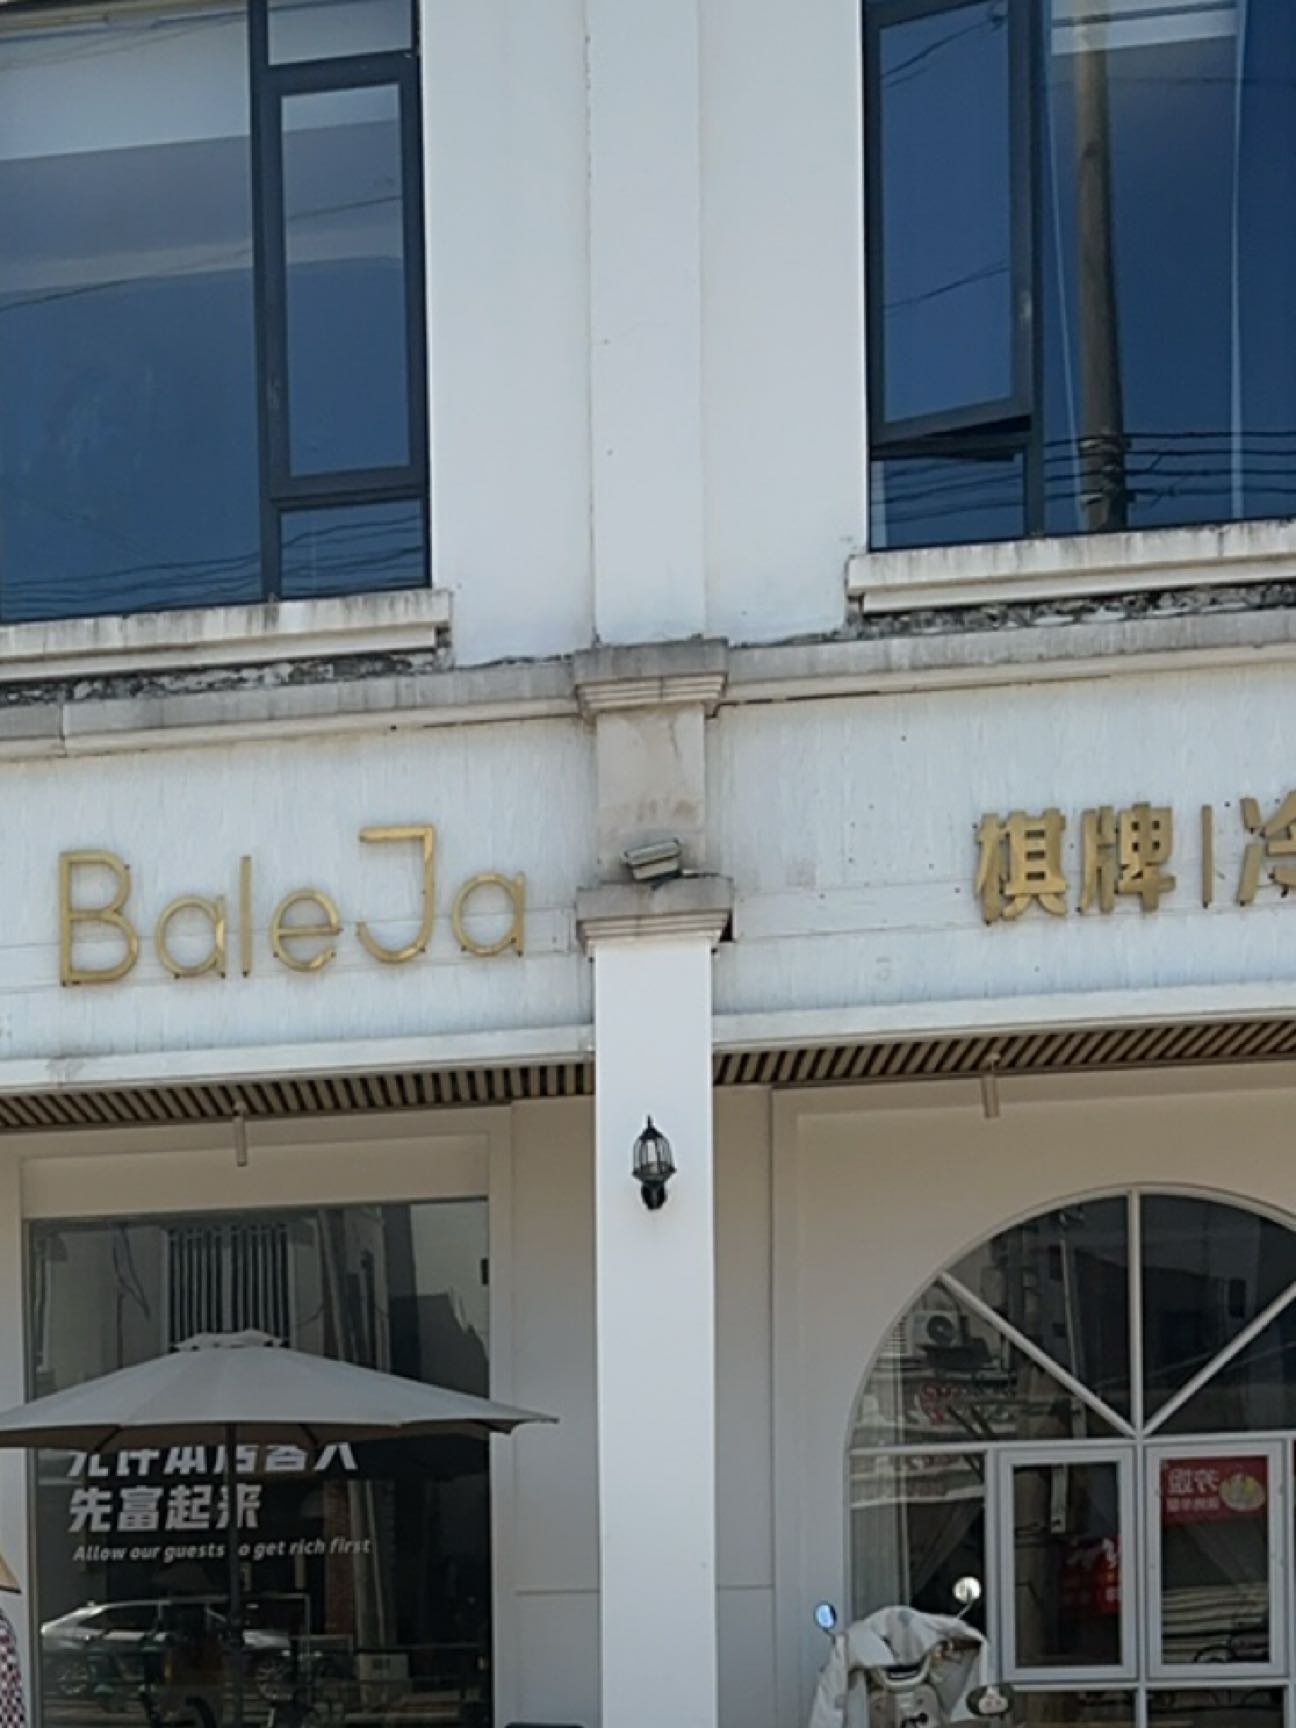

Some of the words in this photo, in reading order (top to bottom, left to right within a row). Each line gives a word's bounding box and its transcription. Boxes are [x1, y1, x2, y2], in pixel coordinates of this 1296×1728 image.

[58, 823, 527, 988] BaleJa
[68, 1483, 263, 1533] 先富起来
[72, 1545, 126, 1562] Allow
[129, 1546, 161, 1560] our
[162, 1542, 225, 1564] guests
[253, 1540, 286, 1562] get
[289, 1538, 325, 1555] rich
[329, 1536, 371, 1555] first
